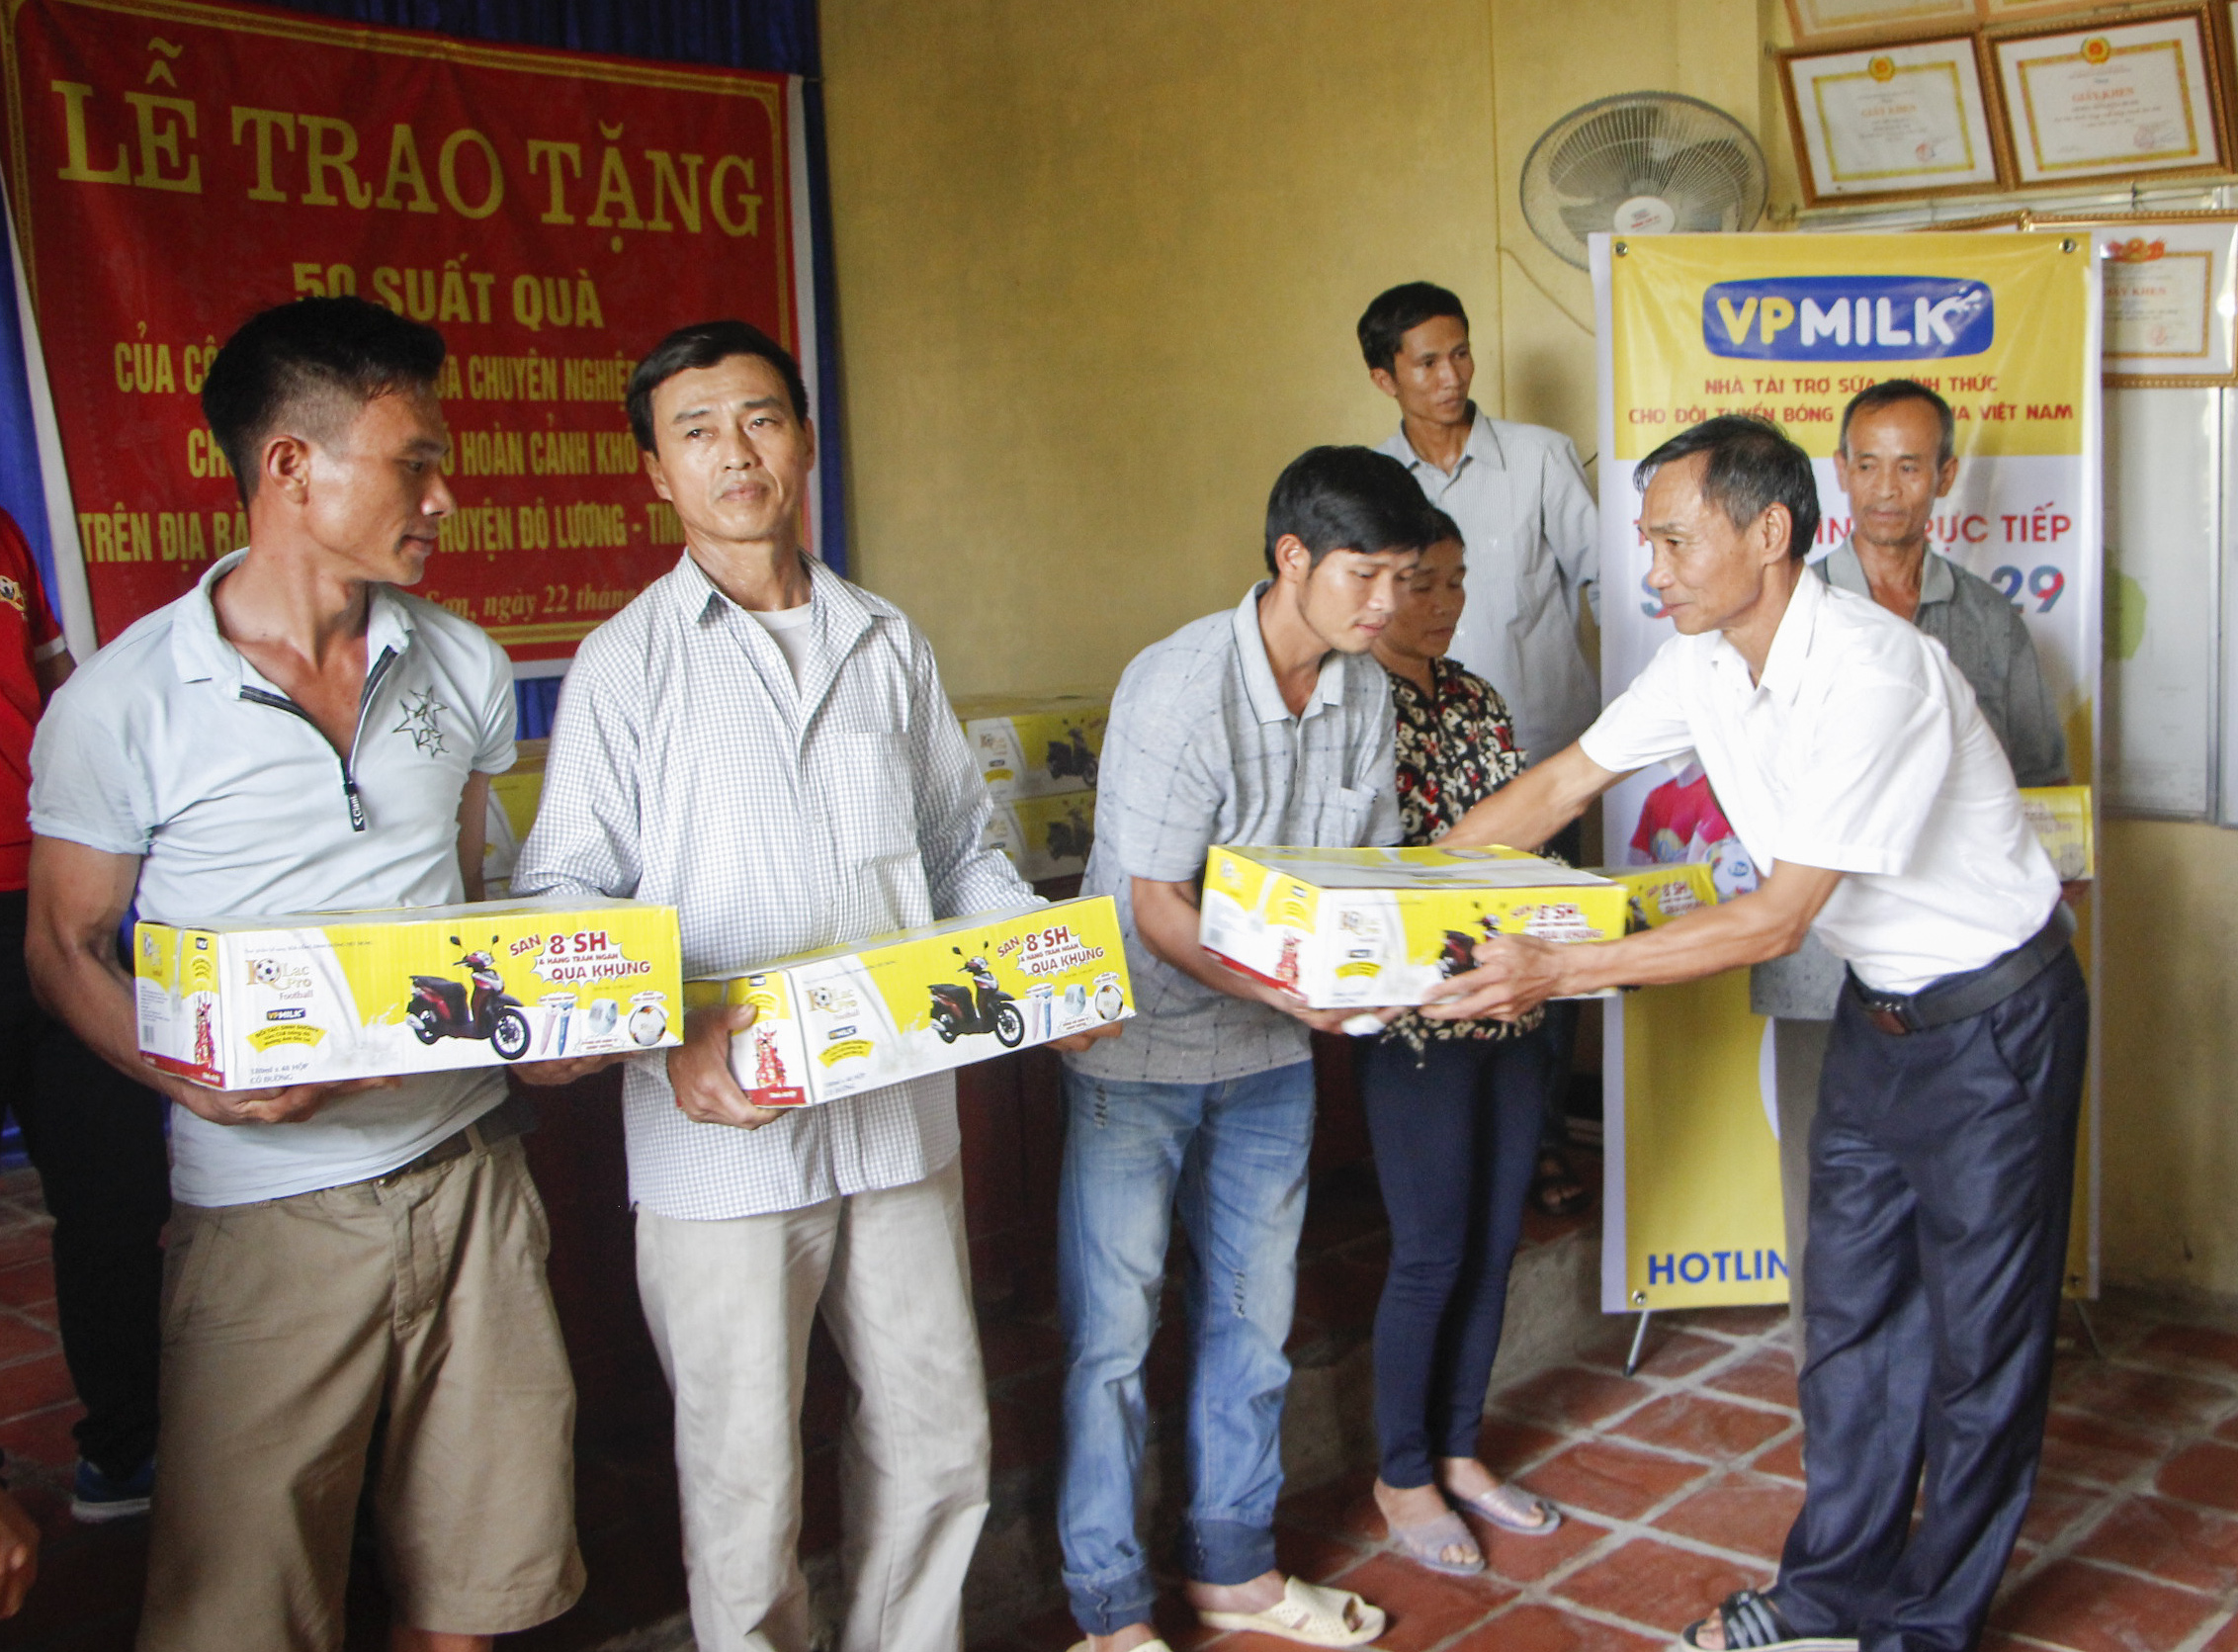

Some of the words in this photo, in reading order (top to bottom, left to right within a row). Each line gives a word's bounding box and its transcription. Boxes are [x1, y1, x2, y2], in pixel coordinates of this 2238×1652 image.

[49, 37, 203, 194] LỄ
[231, 105, 505, 219] TRAO
[527, 119, 763, 254] TẶNG
[512, 258, 605, 332] QUÀ
[114, 320, 176, 393] CỦA
[468, 347, 559, 401] CHUYÊN
[1704, 376, 1745, 394] NHÀ
[1754, 375, 1784, 393] TÀI
[1792, 377, 1832, 397] TRỢ
[1948, 373, 1998, 392] THỨC
[1628, 407, 1666, 424] CHO
[1783, 402, 1835, 423] BÓNG
[1980, 401, 2017, 423] VIỆT
[2026, 404, 2074, 420] NAM
[461, 421, 526, 476] HOÀN
[529, 411, 591, 476] CẢNH
[78, 501, 153, 563] TRÊN
[158, 511, 208, 572] ĐỊA
[2001, 500, 2072, 543] TIẾP
[484, 587, 537, 622] ngày
[543, 583, 568, 613] 22
[550, 935, 565, 955] 8
[574, 931, 607, 953] SH
[1026, 933, 1039, 952] 8
[1043, 926, 1070, 948] SH
